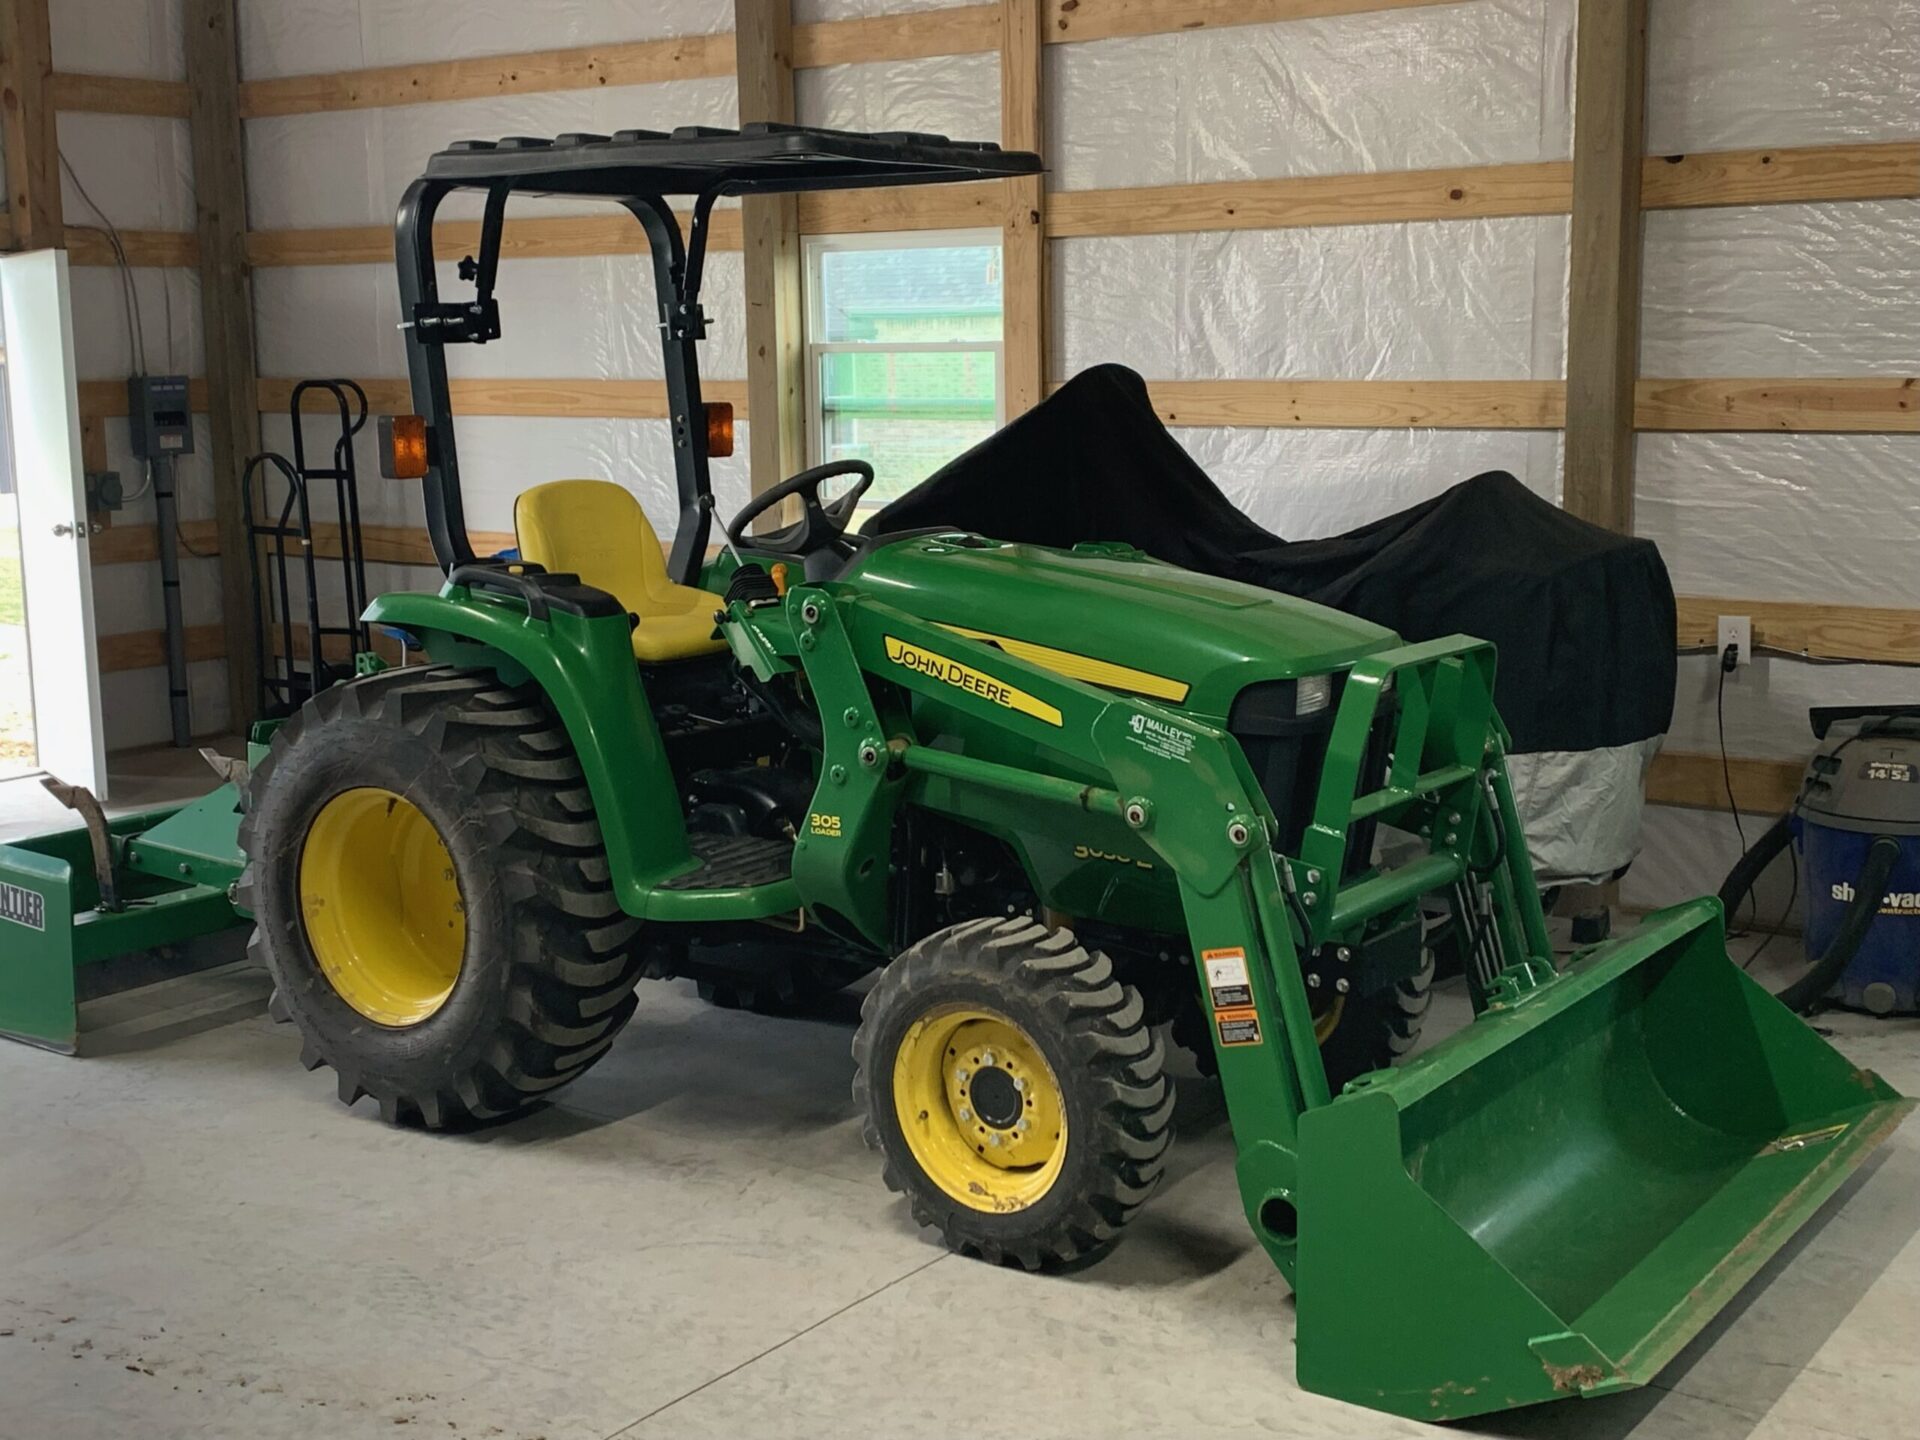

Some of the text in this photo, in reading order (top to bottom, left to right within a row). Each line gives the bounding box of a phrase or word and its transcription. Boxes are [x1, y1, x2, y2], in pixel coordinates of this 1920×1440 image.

[892, 645, 1012, 704] JOHN DEERE
[810, 813, 841, 829] 305
[810, 827, 842, 837] LOADER
